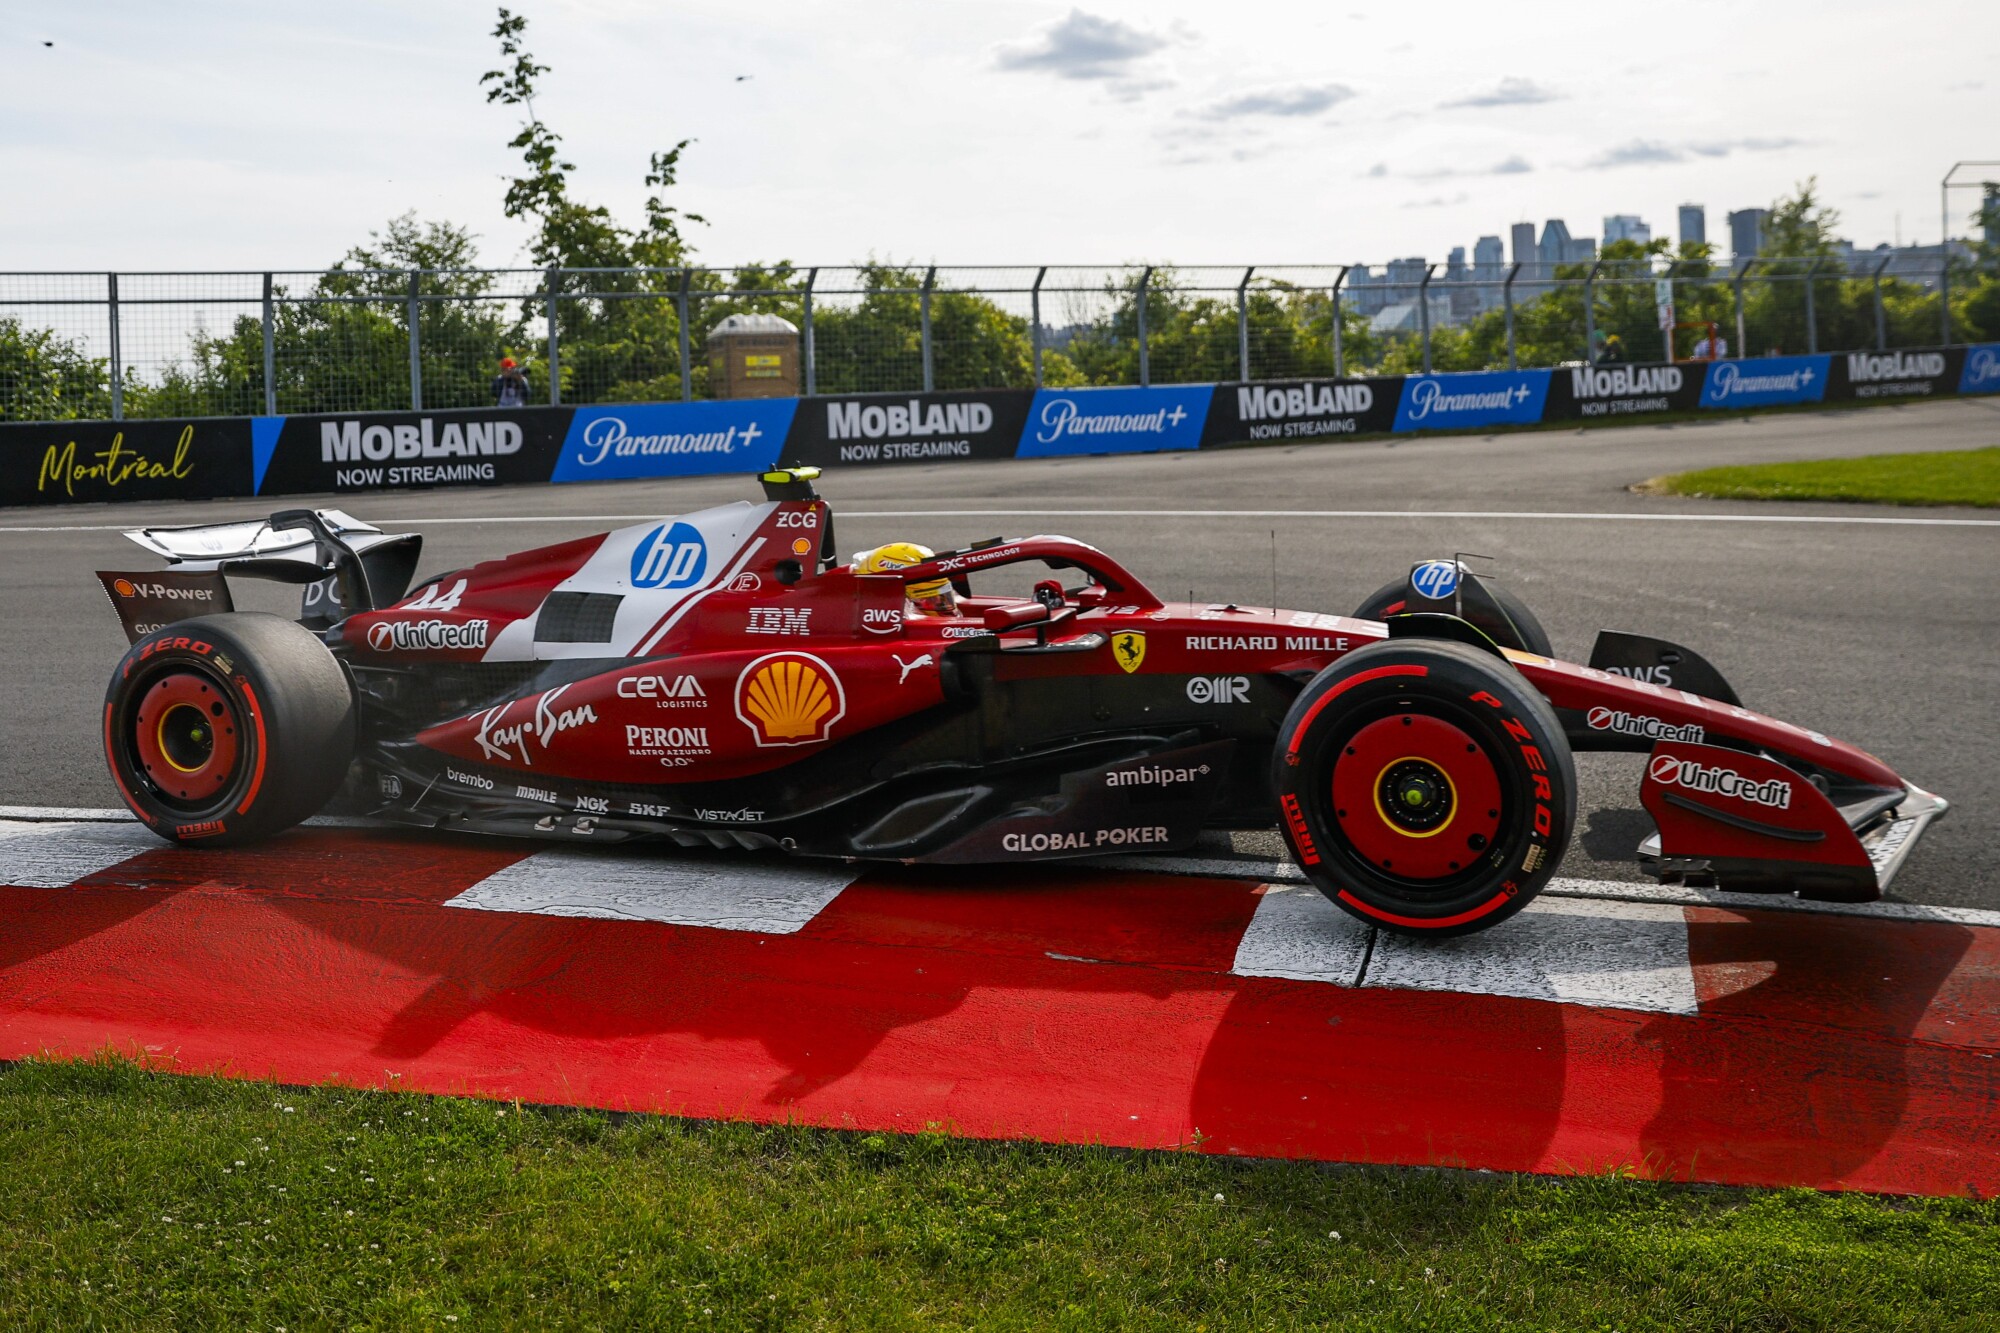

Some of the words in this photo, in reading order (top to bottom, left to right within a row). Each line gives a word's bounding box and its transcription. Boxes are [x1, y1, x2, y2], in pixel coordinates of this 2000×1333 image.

[1571, 365, 1683, 398] MOBLAND
[1237, 383, 1374, 420] MOBLAND
[1408, 380, 1531, 420] Paramount+
[1581, 401, 1608, 415] NOW
[1610, 397, 1669, 414] STREAMING
[827, 399, 993, 439] MOBLAND
[1036, 399, 1187, 443] Paramount+
[1250, 423, 1282, 439] NOW
[1284, 418, 1356, 437] STREAMING
[320, 418, 523, 462] MOBLAND
[577, 417, 762, 466] Paramount+
[841, 445, 879, 461] NOW
[883, 440, 970, 458] STREAMING
[38, 424, 194, 496] Montréal
[337, 468, 383, 486] NOW
[388, 463, 495, 484] STREAMING
[632, 522, 706, 589] hp
[966, 547, 1020, 563] TECHNOLOGY
[134, 583, 213, 601] V-Power
[1414, 562, 1458, 599] hp
[399, 578, 468, 611] 44
[745, 608, 812, 636] IBM
[863, 608, 901, 623] aws
[393, 620, 488, 649] UniCredit
[1185, 636, 1278, 650] RICHARD
[1285, 637, 1349, 651] MILLE
[139, 637, 213, 661] ZERO
[656, 700, 708, 708] LOGISTICS
[625, 724, 709, 748] PERONI
[1612, 711, 1705, 743] UniCredit
[667, 748, 712, 756] AZZURRO
[1469, 690, 1503, 709] P
[1501, 717, 1552, 837] ZERO
[447, 766, 494, 790] brembo
[1106, 766, 1198, 787] ambipar
[1678, 760, 1791, 810] UniCredit
[516, 785, 557, 804] MAHLE
[576, 795, 610, 812] NGK
[628, 802, 671, 817] SKF
[176, 820, 226, 839] PIRELLI
[1002, 831, 1090, 851] GLOBAL
[1095, 826, 1168, 846] POKER
[1280, 793, 1321, 865] PIRELLI
